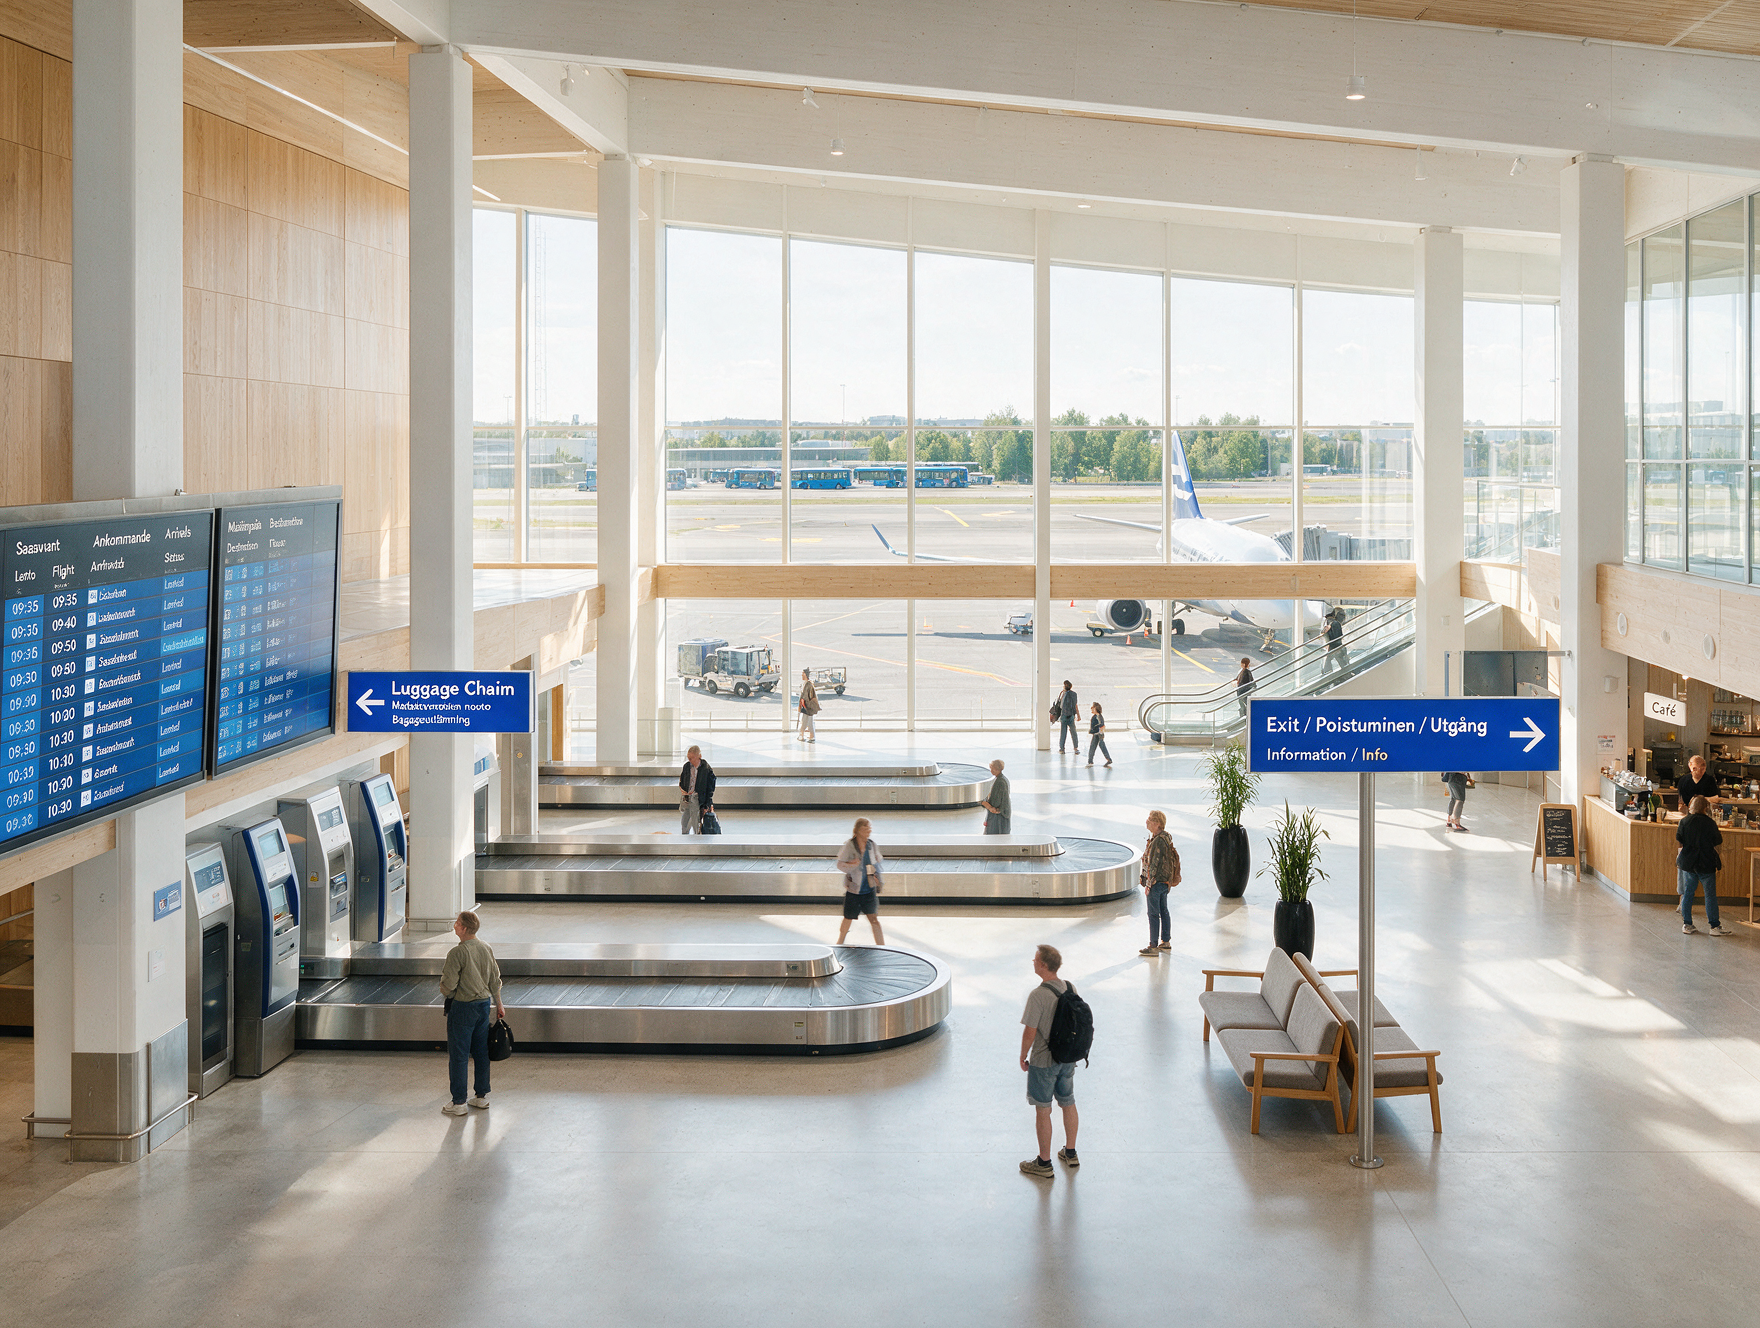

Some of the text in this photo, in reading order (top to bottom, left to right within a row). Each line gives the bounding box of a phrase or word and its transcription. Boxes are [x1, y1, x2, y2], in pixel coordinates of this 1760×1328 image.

[391, 680, 460, 700] Luggage
[1652, 701, 1677, 717] Café
[1267, 716, 1300, 733] Exit
[1303, 716, 1311, 734] /
[1316, 716, 1415, 733] Poistuminen
[1431, 716, 1488, 737] Utgång
[1267, 747, 1388, 762] Information / Info
